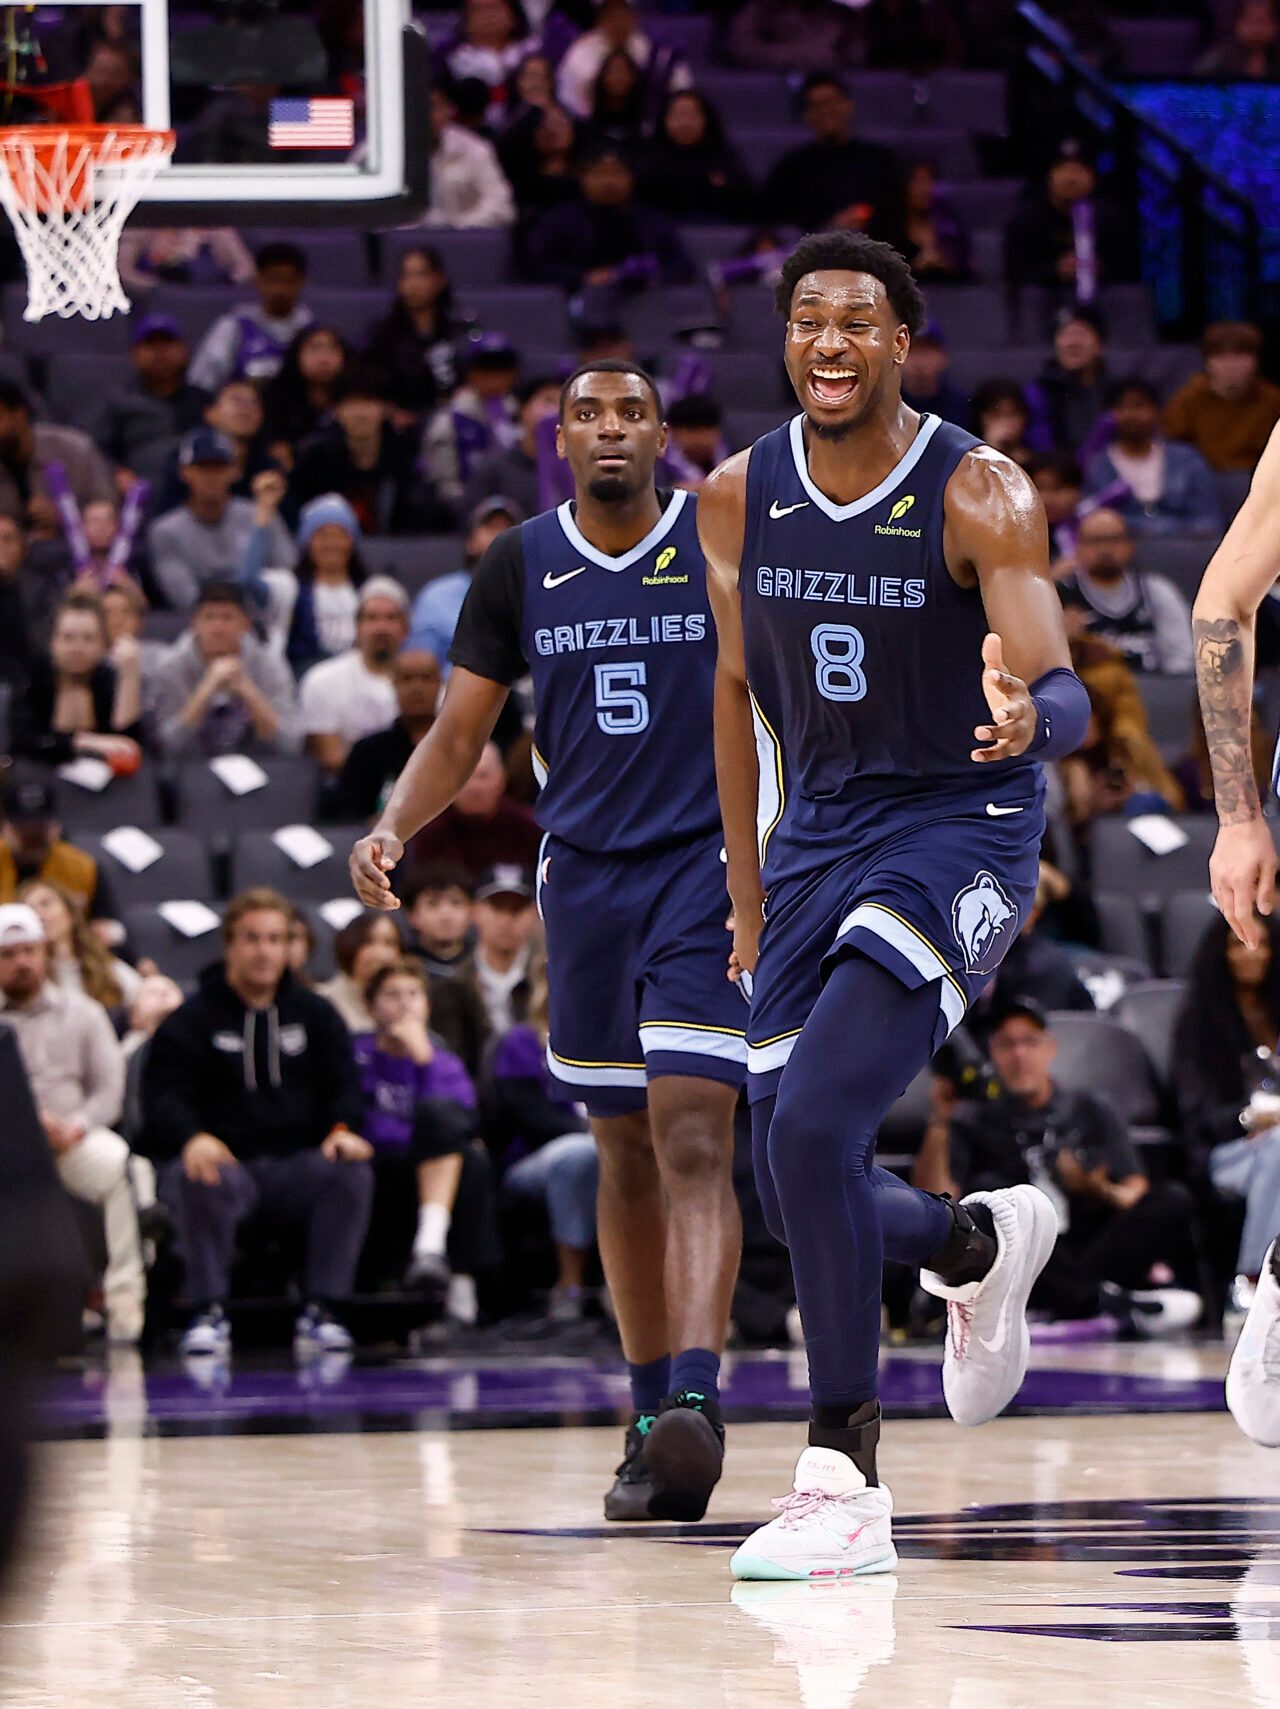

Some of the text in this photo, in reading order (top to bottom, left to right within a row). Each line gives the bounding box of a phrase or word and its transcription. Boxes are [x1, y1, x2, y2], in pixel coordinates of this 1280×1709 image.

[874, 524, 921, 538] Robinhood
[642, 574, 689, 586] Robinhood
[756, 566, 926, 608] GRIZZLIES
[534, 613, 707, 656] GRIZZLIES
[810, 622, 868, 702] 8
[593, 661, 650, 736] 5
